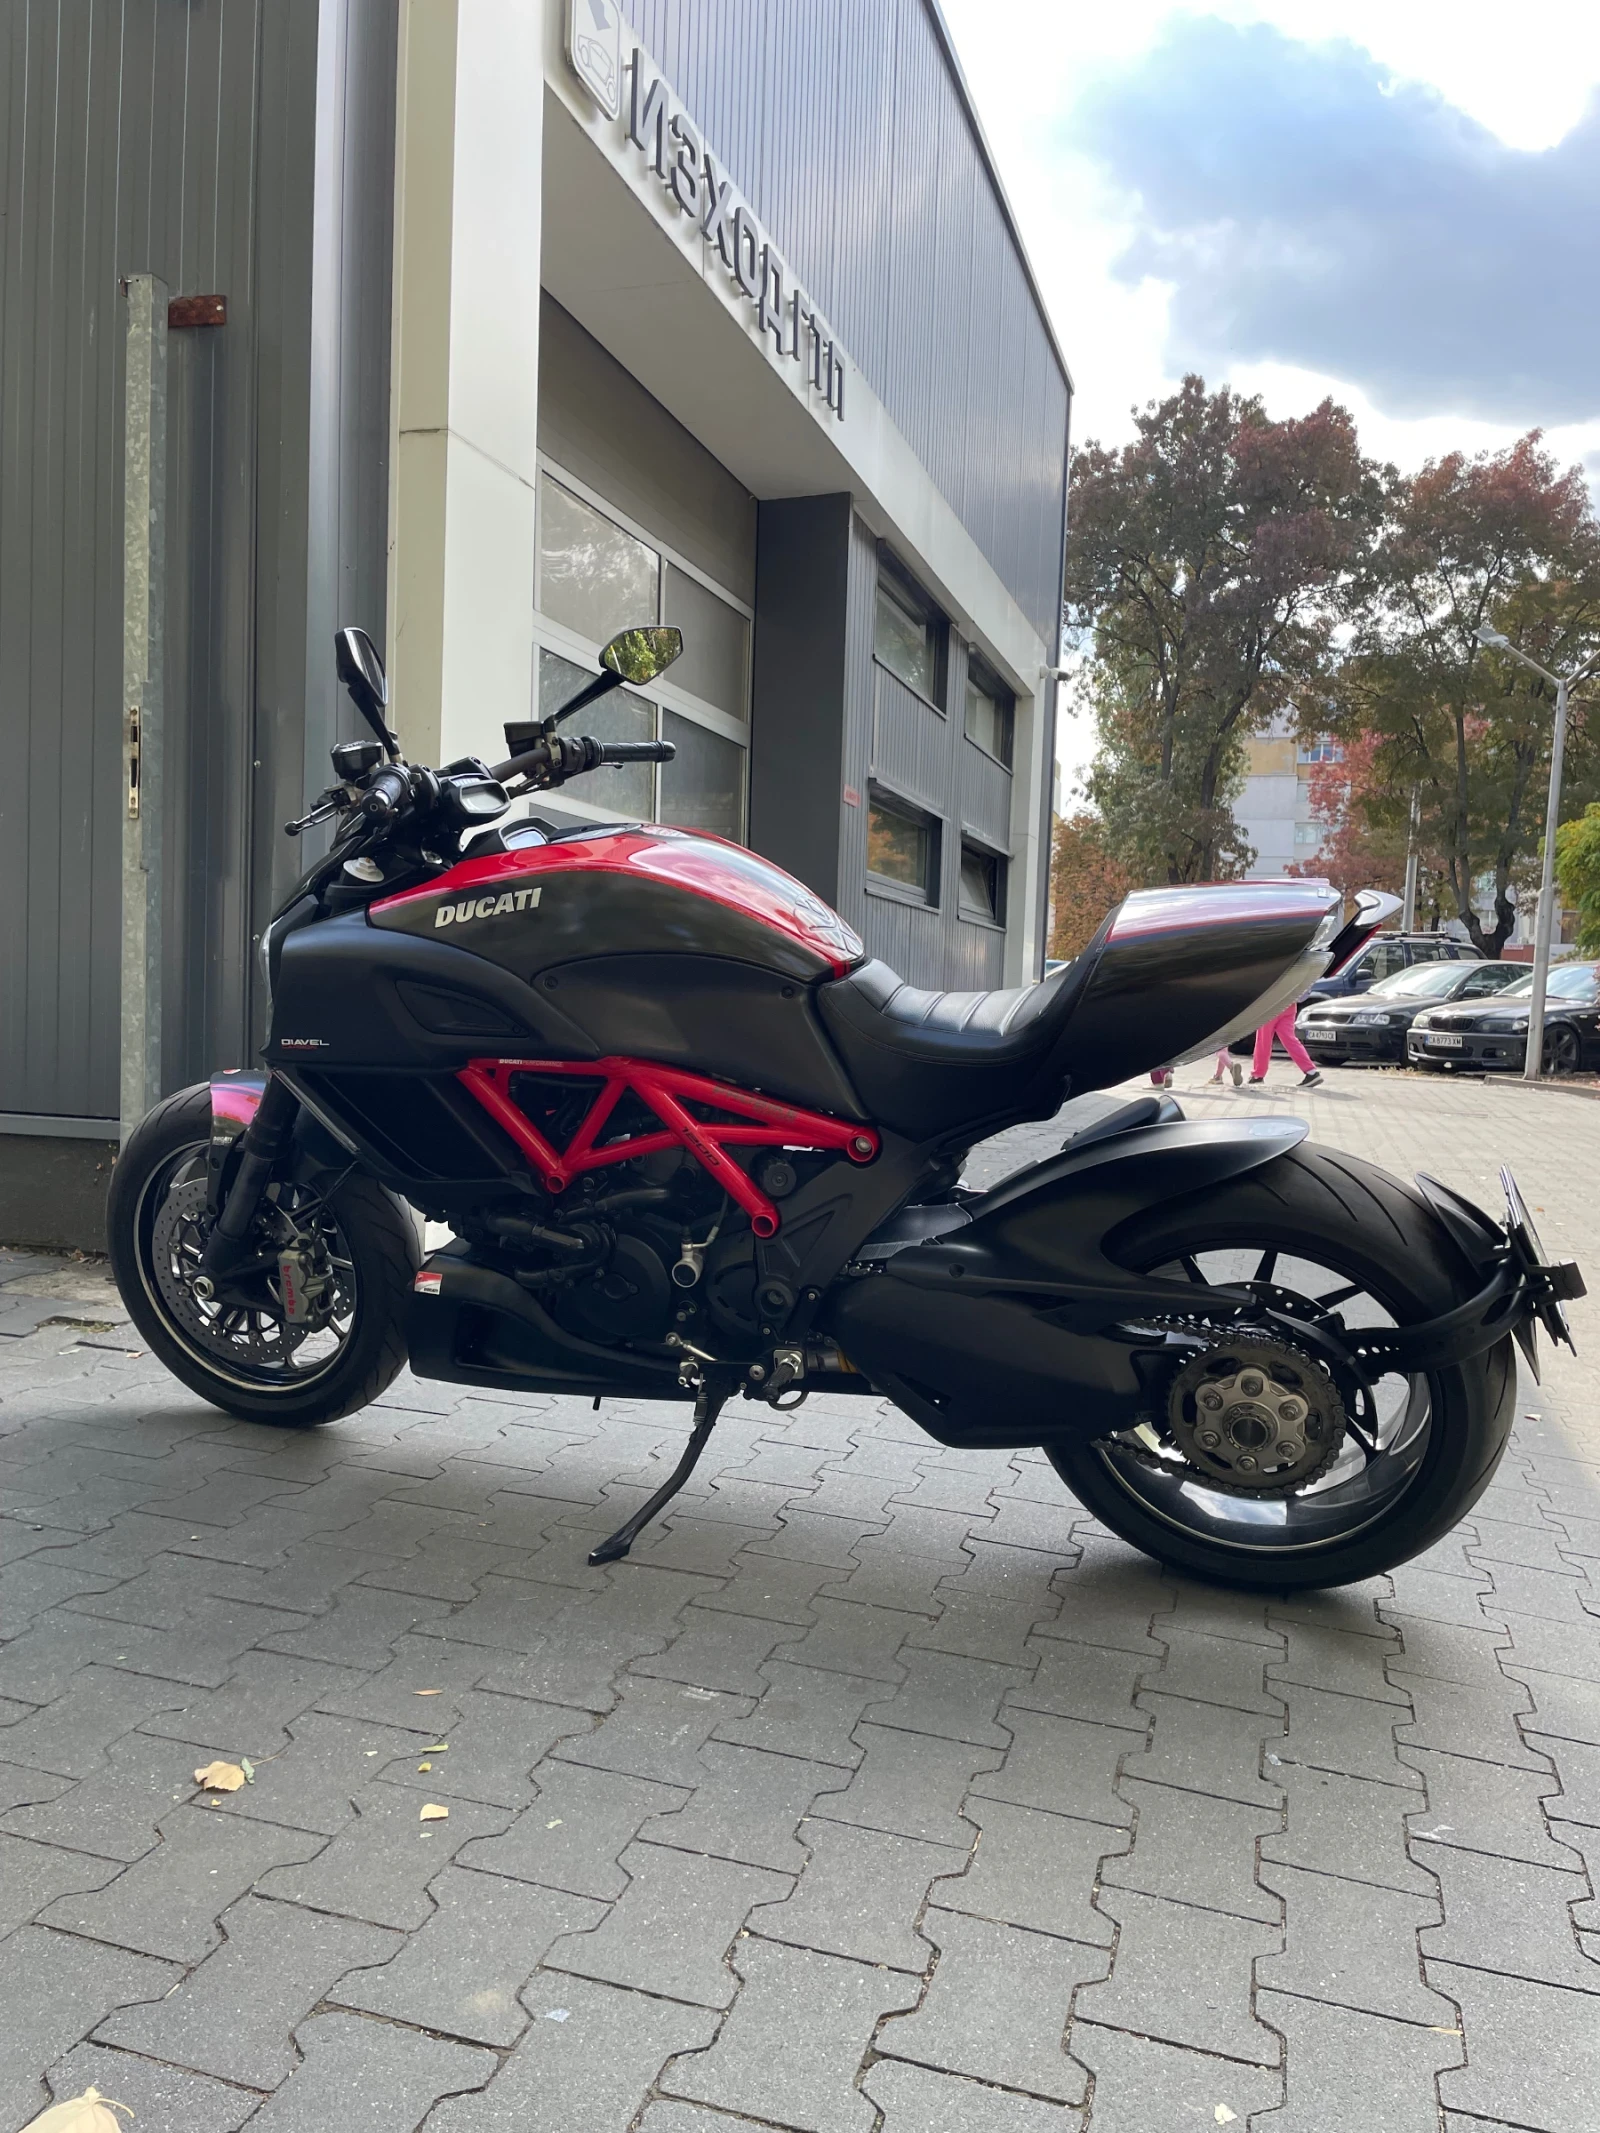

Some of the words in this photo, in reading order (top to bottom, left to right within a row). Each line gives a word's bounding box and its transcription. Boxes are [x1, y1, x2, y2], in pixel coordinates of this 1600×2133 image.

[631, 47, 785, 355] ИЗХОД
[793, 289, 845, 421] ГТП
[434, 887, 542, 928] DUCATI
[281, 1038, 330, 1046] DIAVEL
[682, 1126, 720, 1166] 1200
